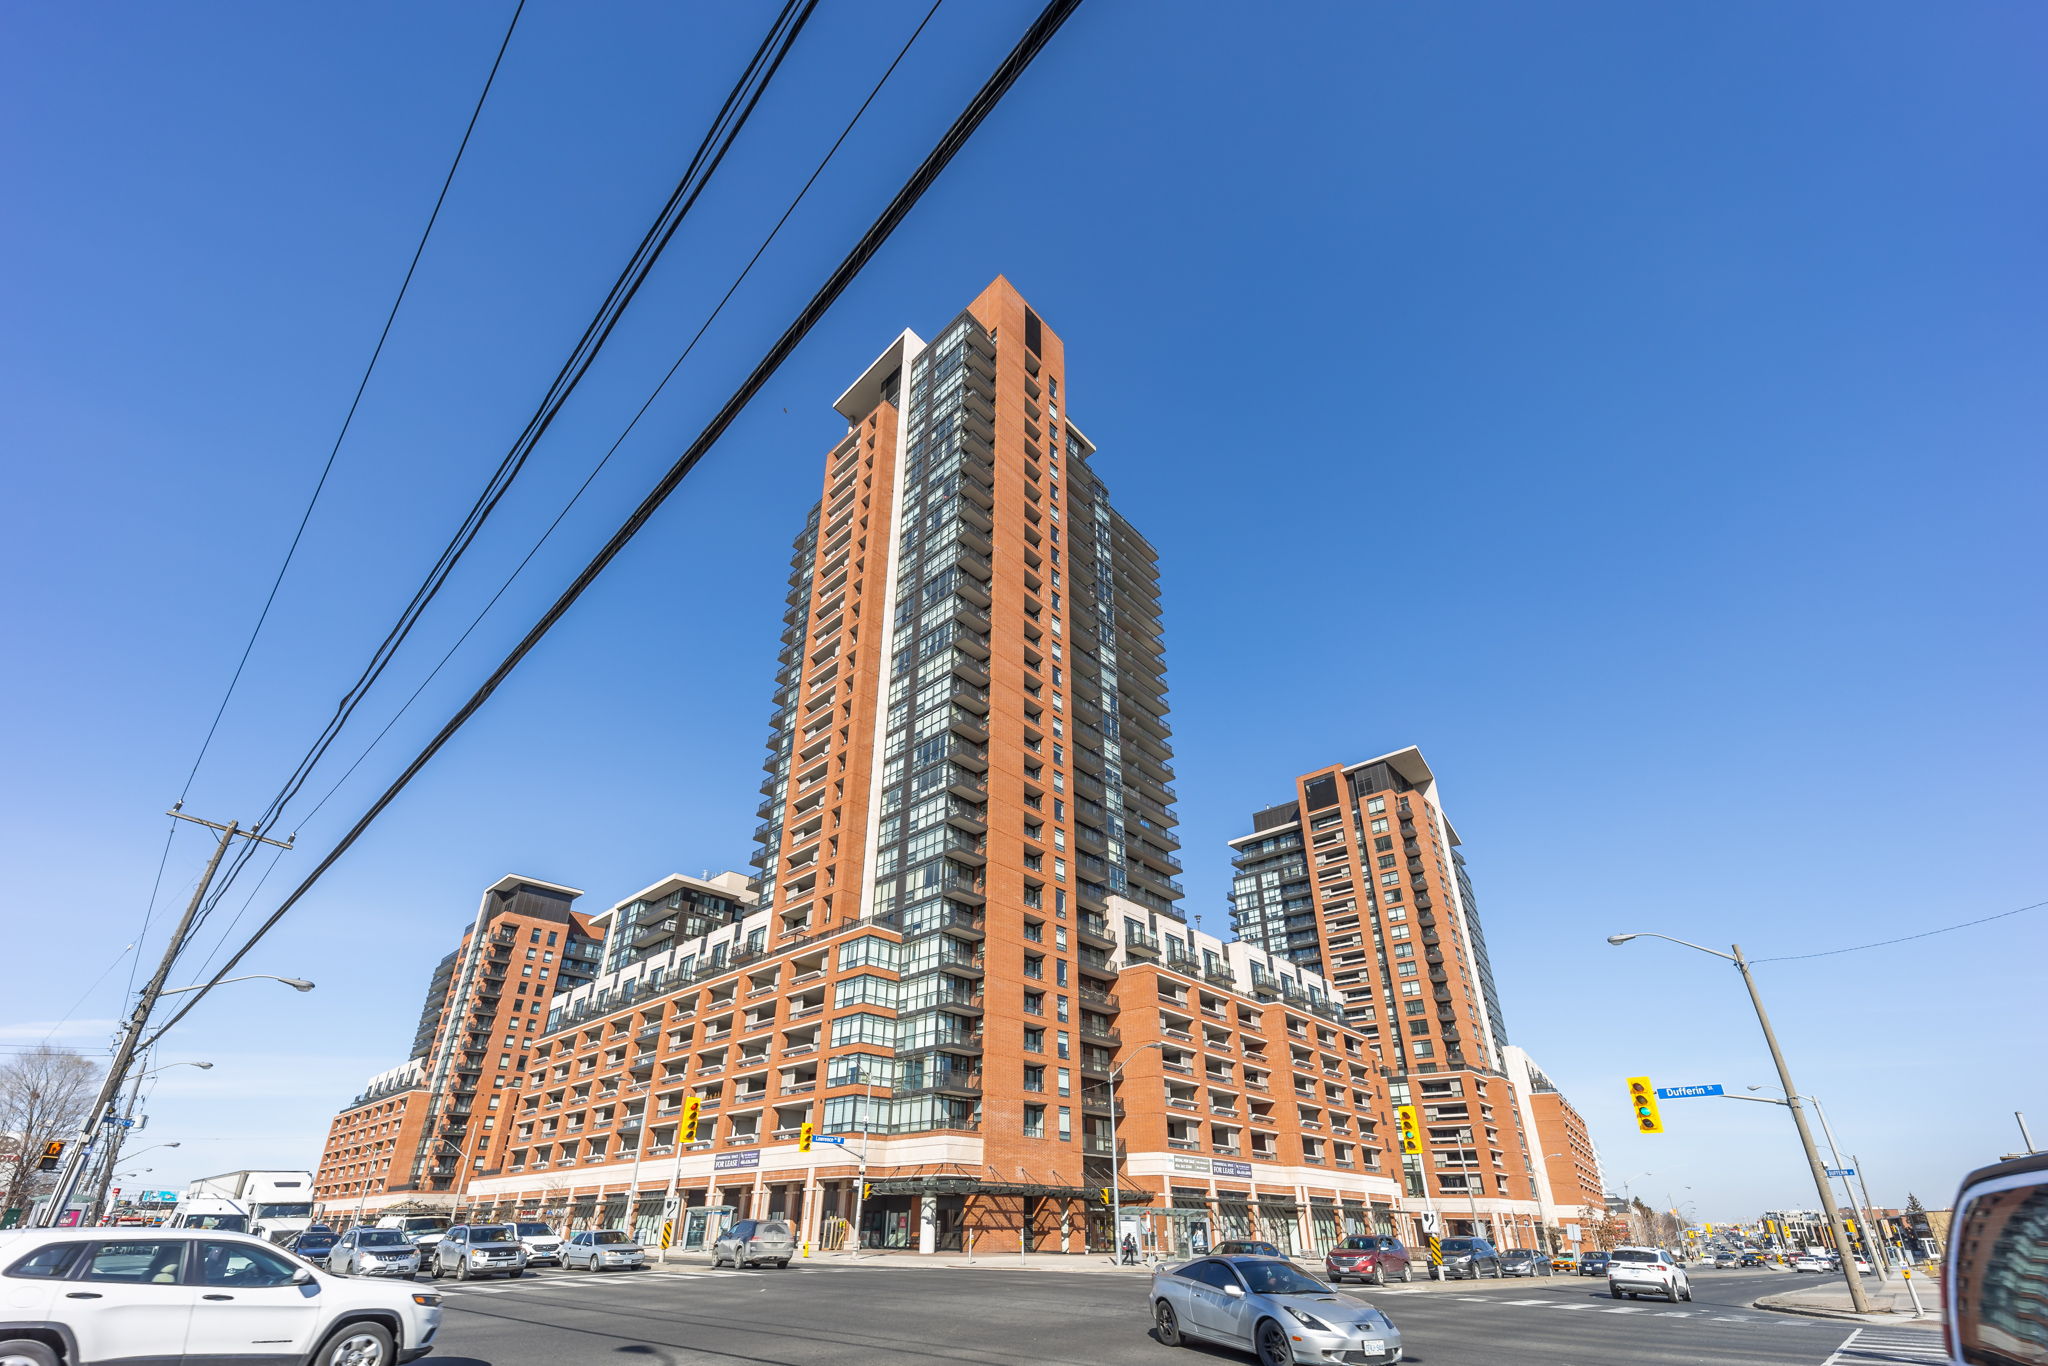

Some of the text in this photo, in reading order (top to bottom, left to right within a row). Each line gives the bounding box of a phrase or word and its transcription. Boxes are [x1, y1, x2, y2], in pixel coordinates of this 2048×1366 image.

[1666, 1087, 1705, 1096] Dufferin
[715, 1160, 724, 1168] FOR
[724, 1159, 738, 1167] LEASE
[1213, 1166, 1222, 1174] FOR
[1222, 1167, 1235, 1175] LEASE
